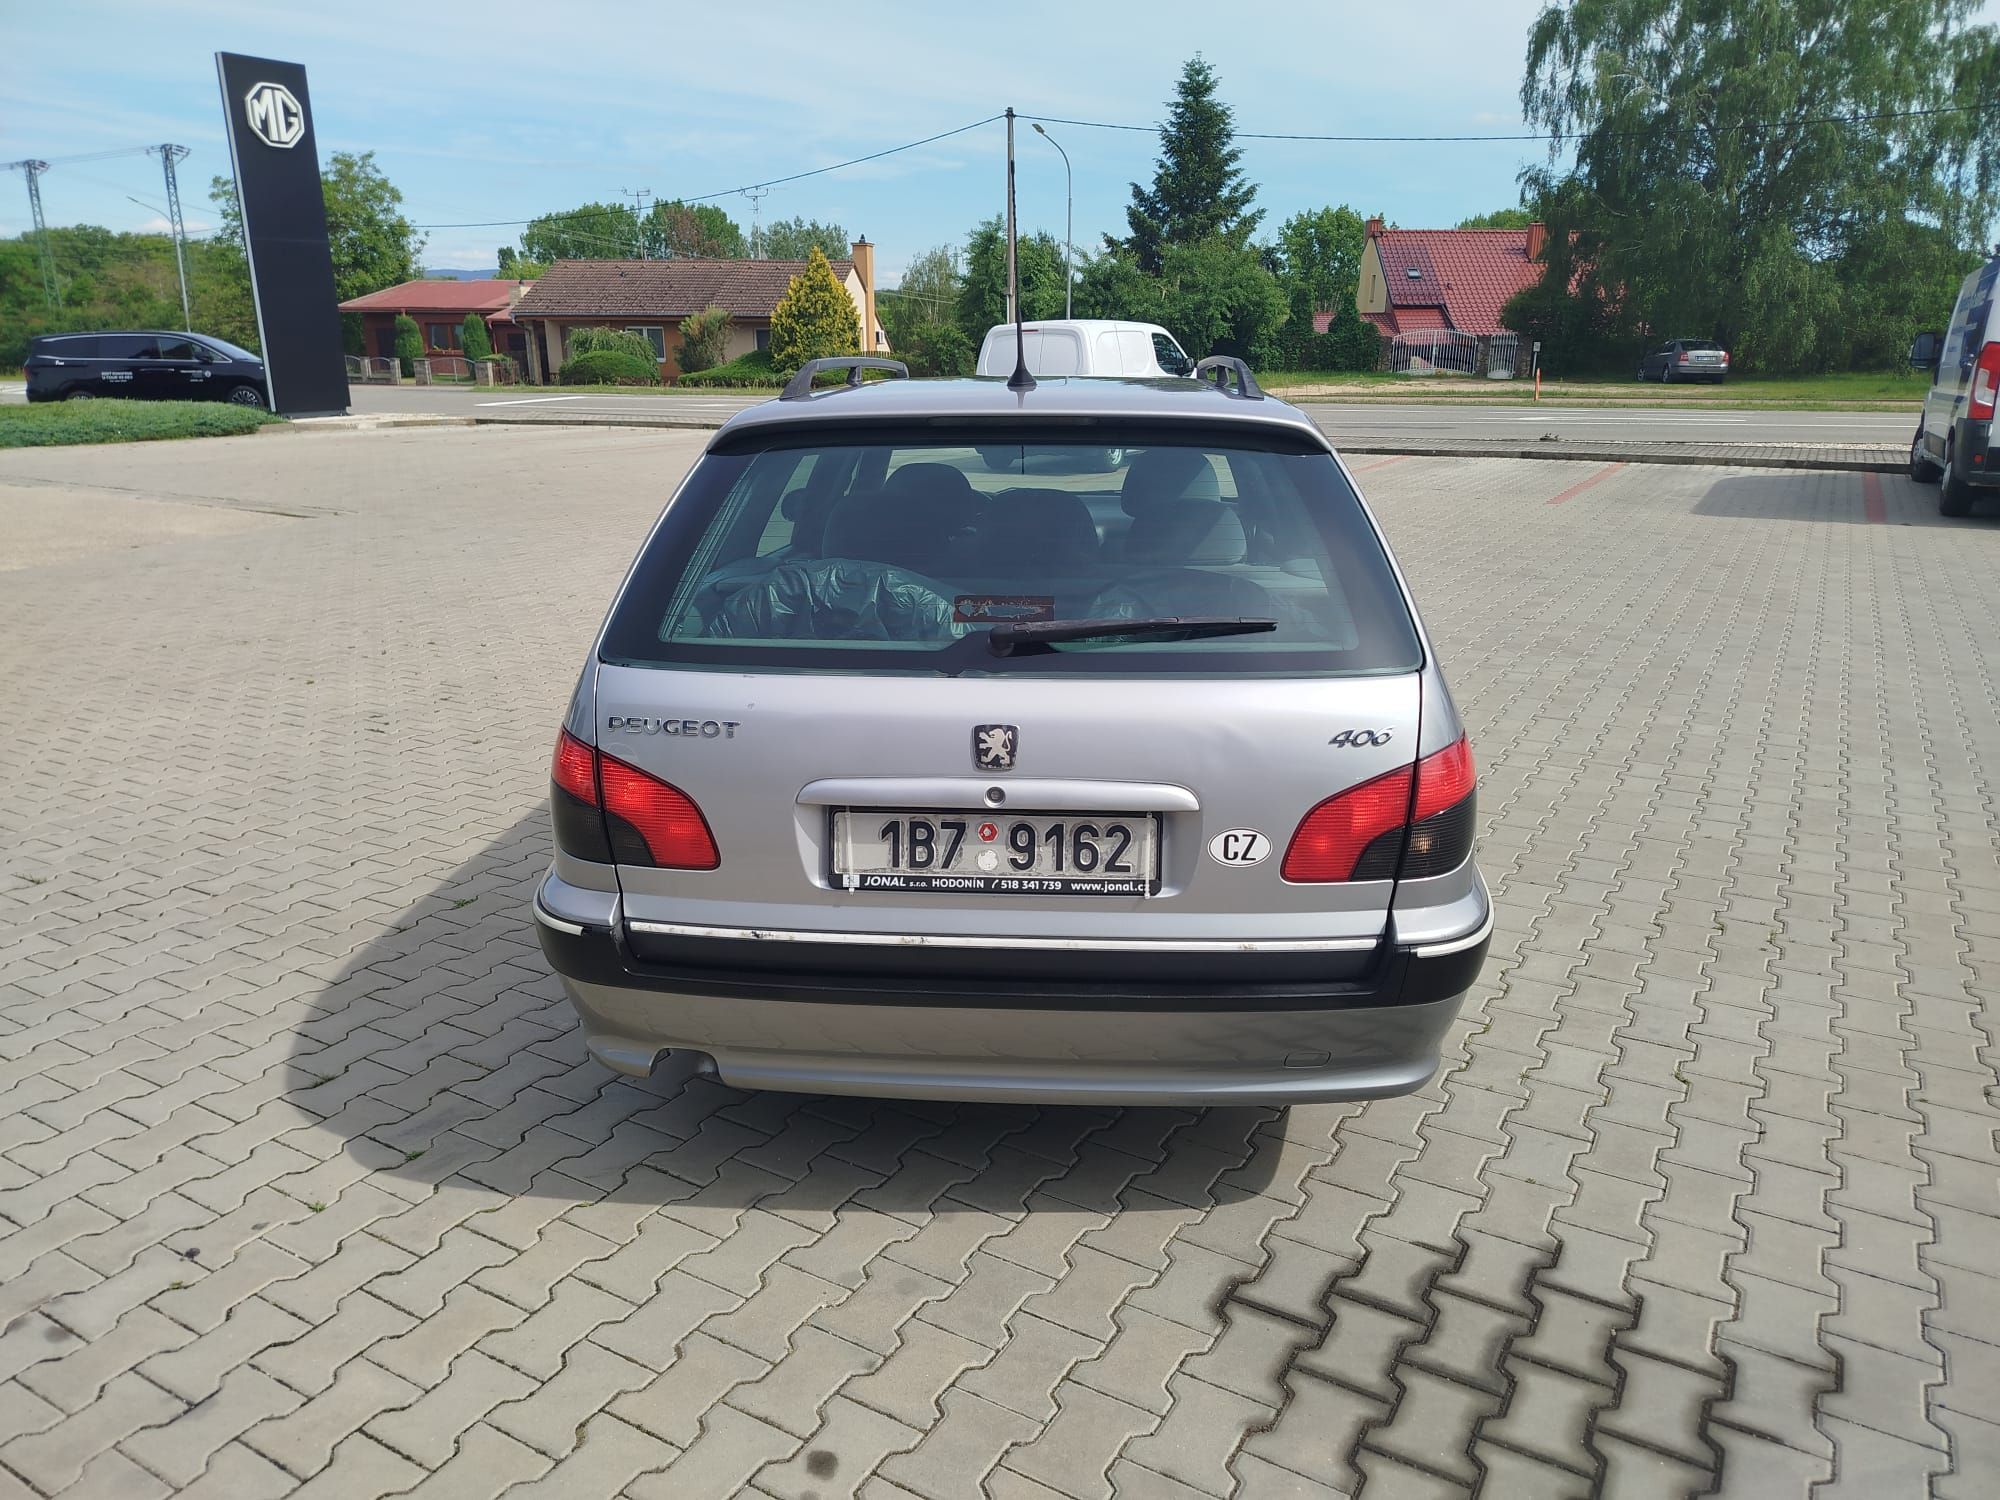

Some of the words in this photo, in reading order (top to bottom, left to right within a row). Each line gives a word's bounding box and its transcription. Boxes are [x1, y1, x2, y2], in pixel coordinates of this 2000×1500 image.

[250, 88, 300, 142] MG
[607, 716, 741, 739] PEUGEOT
[1328, 725, 1394, 748] 406
[879, 820, 967, 870] 1B7
[1009, 822, 1132, 873] 9162
[1223, 833, 1258, 861] CZ
[864, 875, 907, 887] JONAL
[932, 877, 985, 889] HODONÍN
[1000, 879, 1020, 889] 518
[1022, 880, 1040, 890] 341
[1042, 880, 1062, 890] 739
[1070, 880, 1149, 893] www.jonal.c
